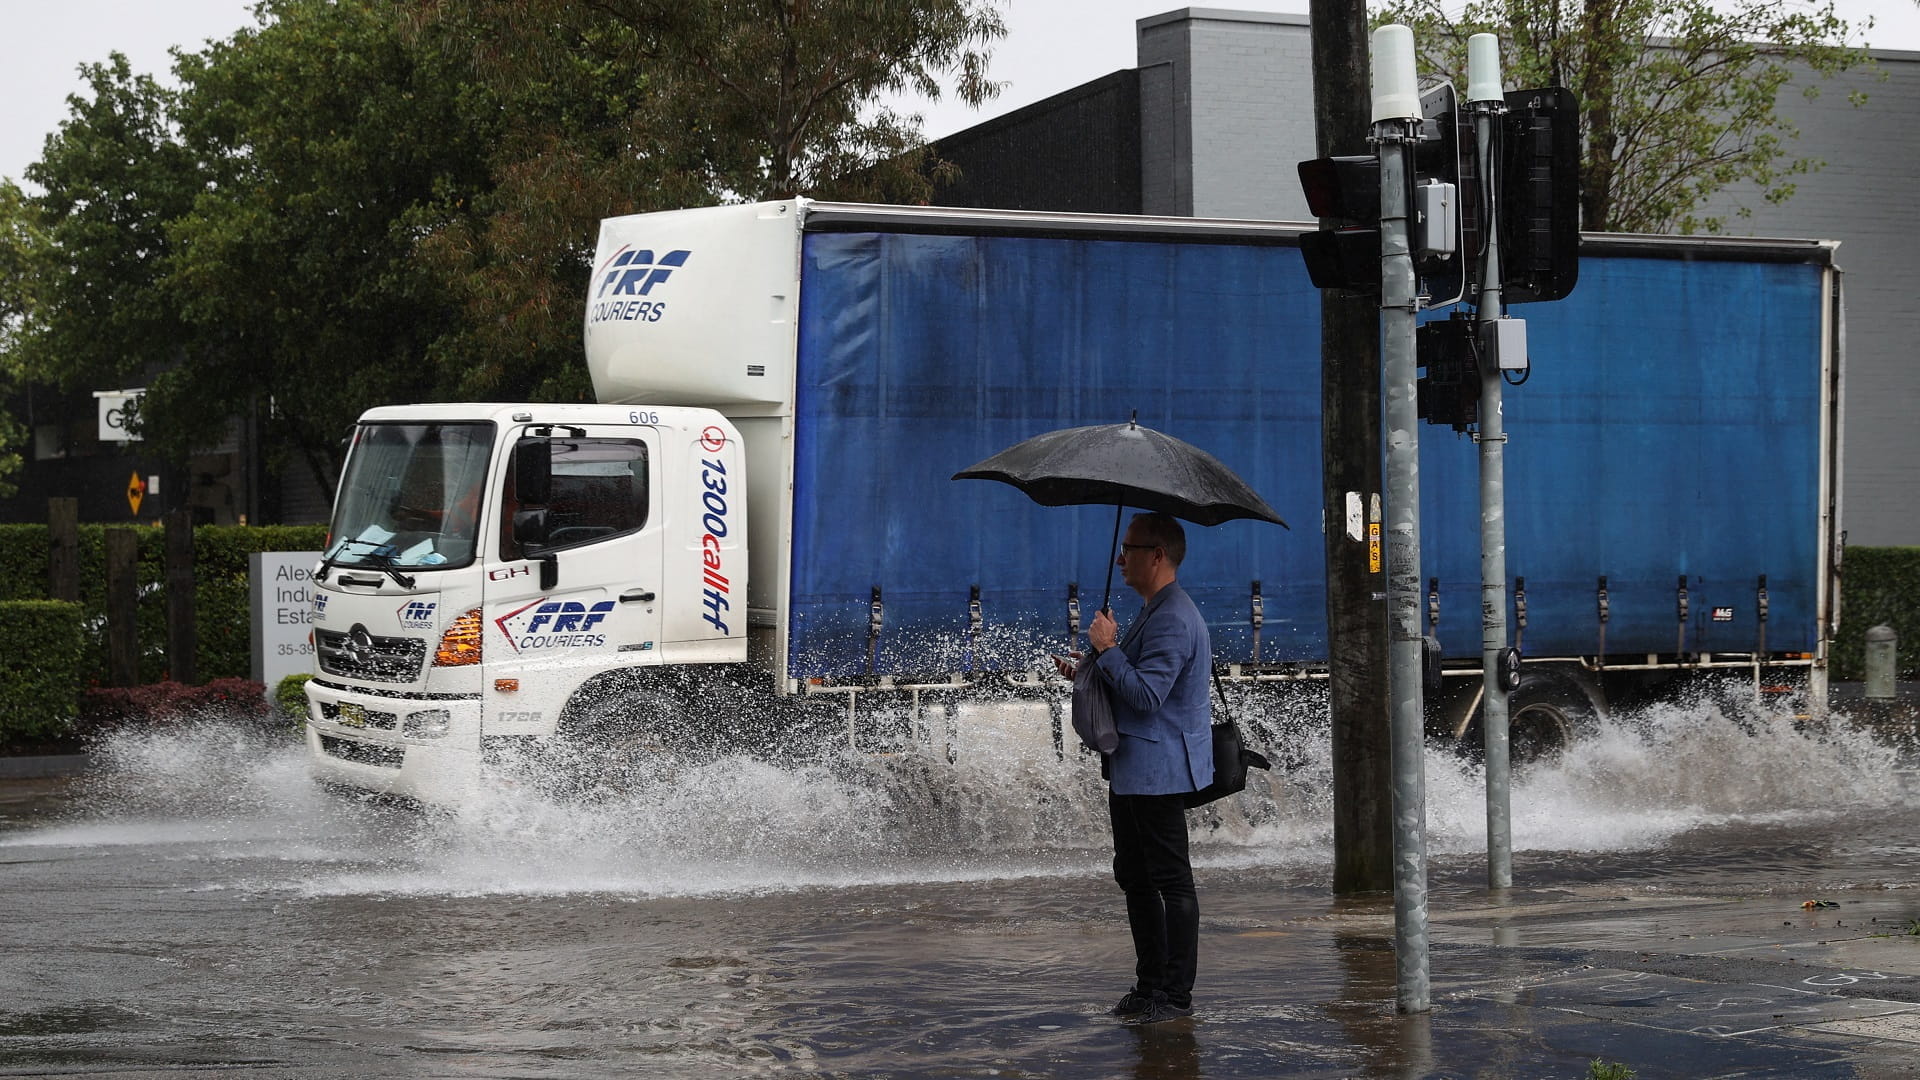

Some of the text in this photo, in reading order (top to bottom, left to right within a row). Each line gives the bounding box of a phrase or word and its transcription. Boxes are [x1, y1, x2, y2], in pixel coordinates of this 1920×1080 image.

[598, 249, 693, 298] FRF
[591, 301, 666, 323] COURIERS
[629, 411, 659, 424] 606
[1371, 527, 1379, 561] GAS
[276, 565, 314, 581] Alex
[489, 565, 530, 581] GH
[405, 602, 437, 620] FRF
[526, 601, 617, 633] FRF
[403, 621, 433, 630] COURIERS
[520, 634, 606, 649] COURIERS
